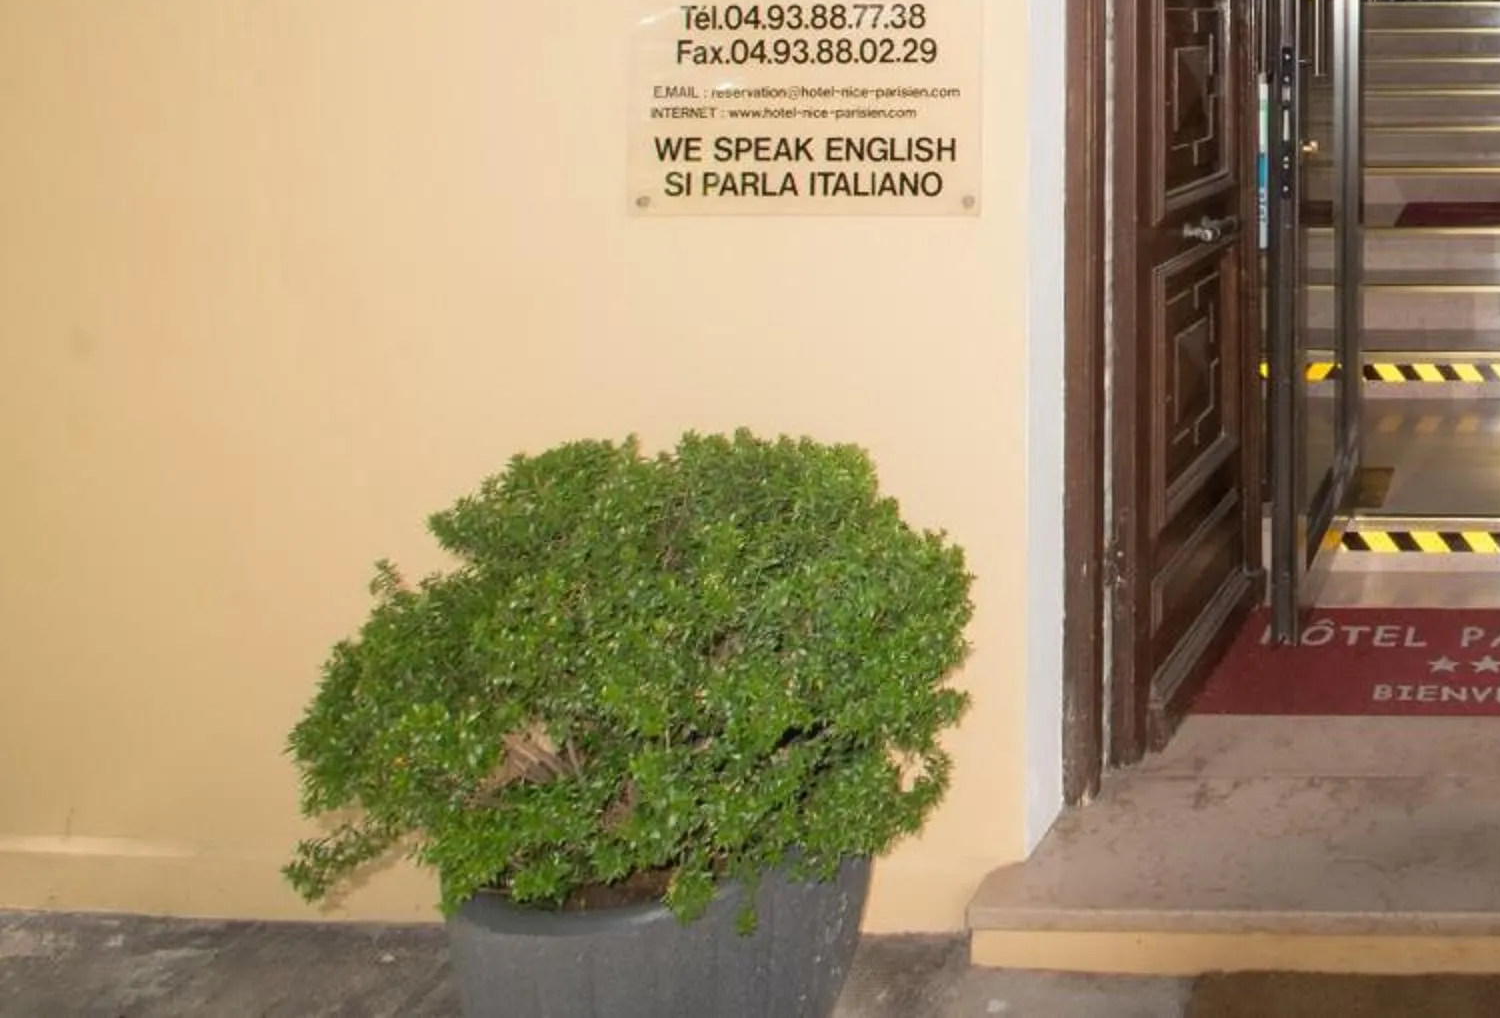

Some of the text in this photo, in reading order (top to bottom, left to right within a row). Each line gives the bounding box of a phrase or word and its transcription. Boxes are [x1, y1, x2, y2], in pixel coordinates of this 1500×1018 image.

[676, 37, 939, 66] Fax.04.93.88.02.29
[710, 84, 962, 101] reservation@hotel-nice-parisien.com
[650, 106, 717, 120] INTERNET
[727, 106, 918, 122] www.hotel-nice-parisien.com
[654, 135, 957, 163] WE SPEAK ENGLISH
[664, 170, 943, 198] SI PARLA ITALIANO
